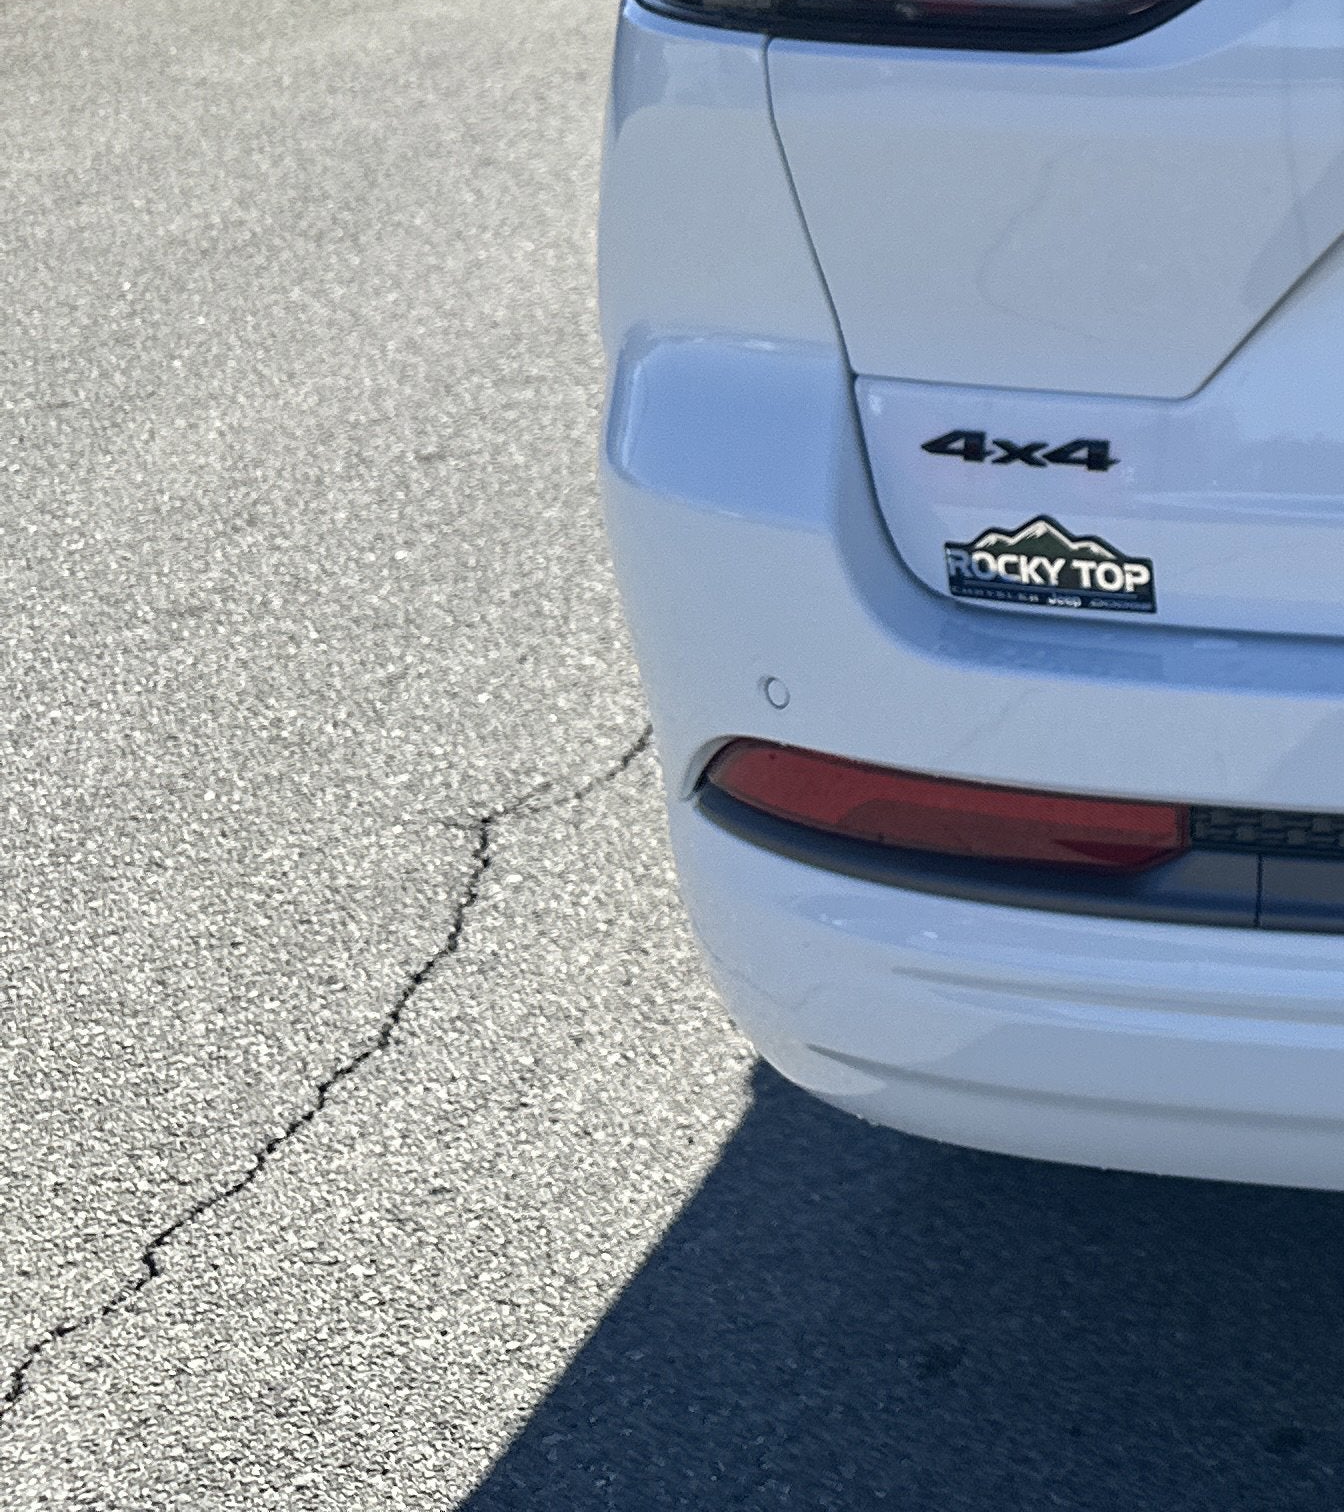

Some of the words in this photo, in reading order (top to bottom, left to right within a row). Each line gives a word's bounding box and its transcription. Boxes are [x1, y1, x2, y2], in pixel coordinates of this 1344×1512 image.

[920, 429, 1121, 472] 4x4
[947, 546, 1067, 587] ROCKY
[1071, 560, 1151, 593] TOP
